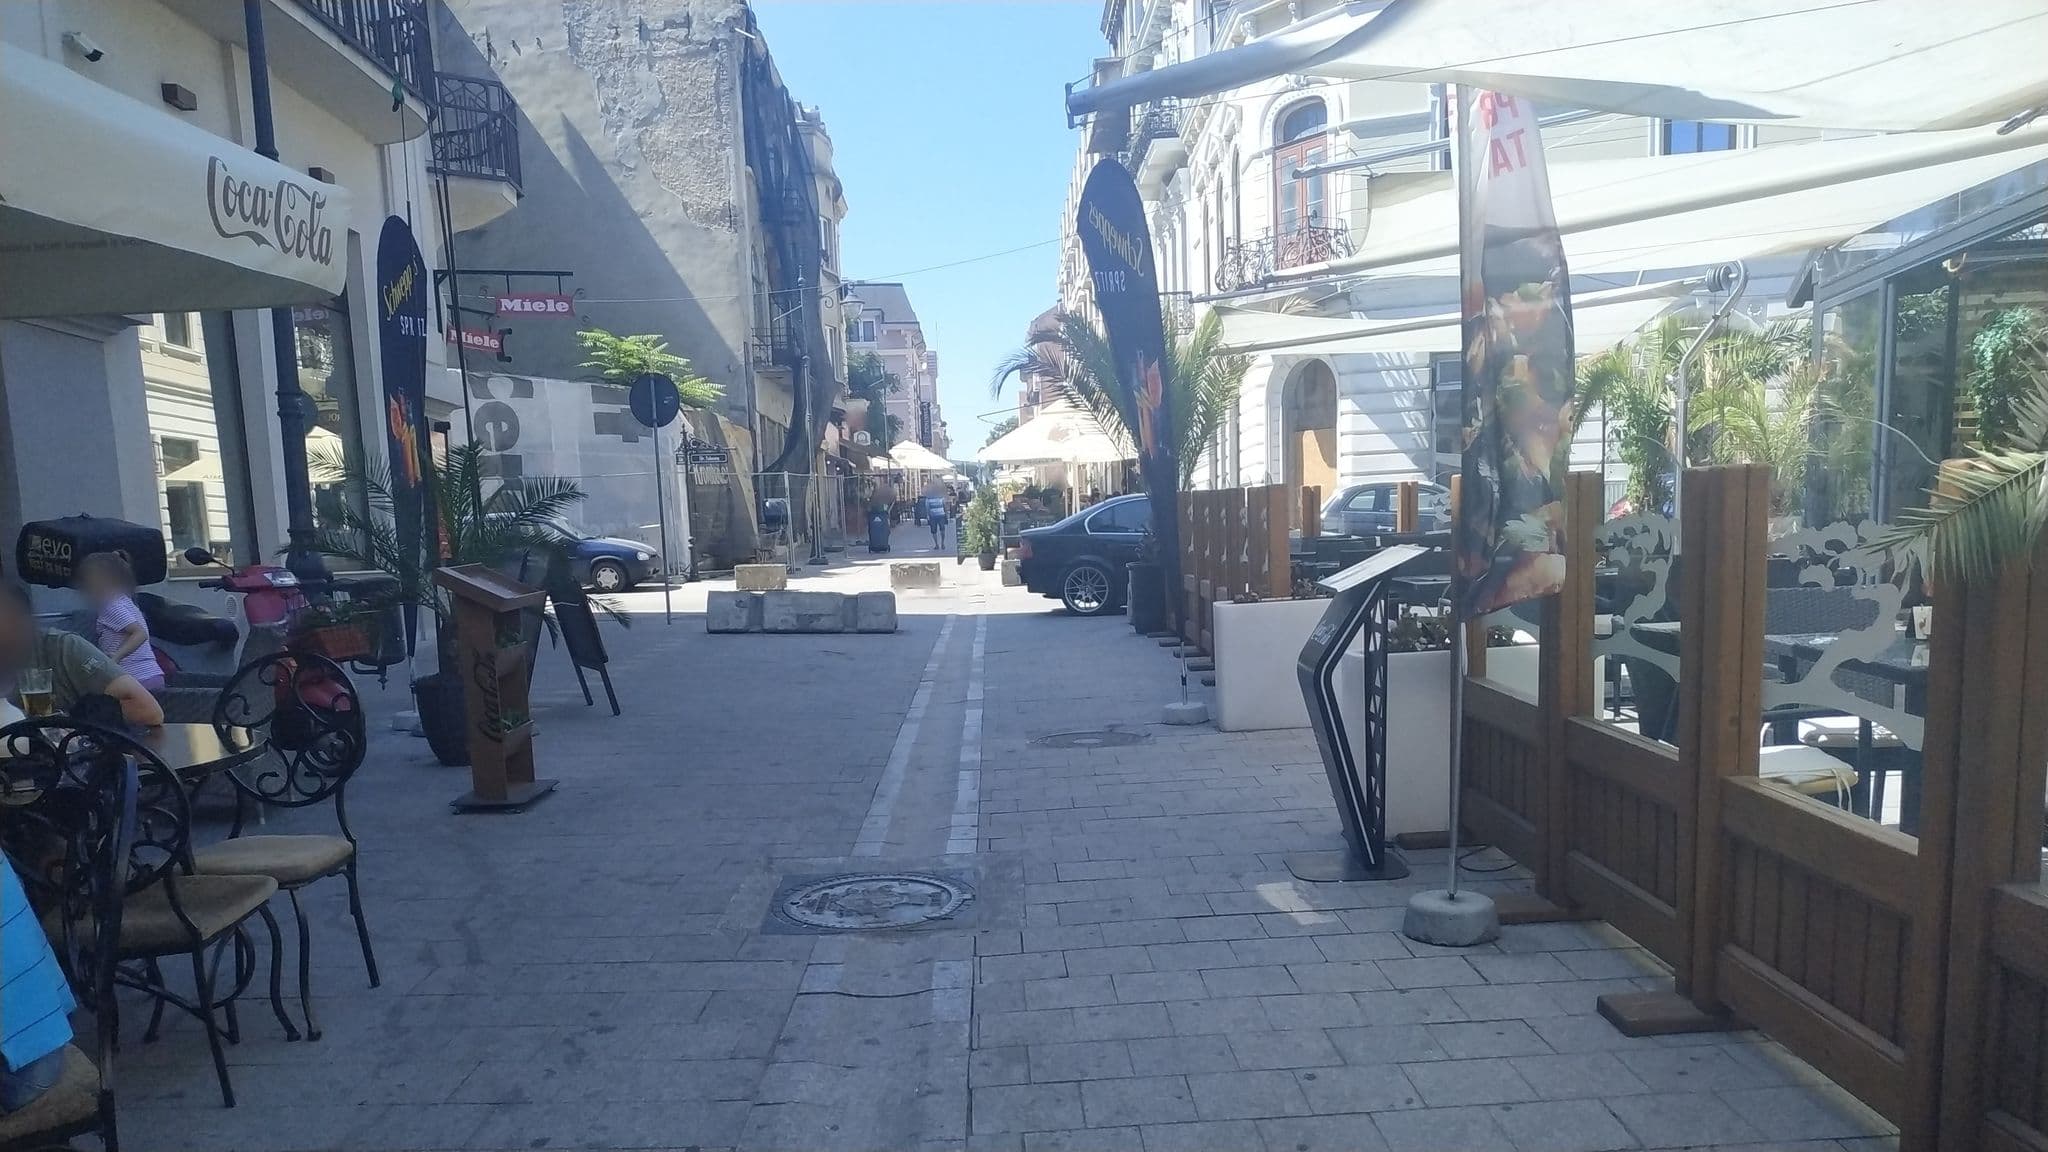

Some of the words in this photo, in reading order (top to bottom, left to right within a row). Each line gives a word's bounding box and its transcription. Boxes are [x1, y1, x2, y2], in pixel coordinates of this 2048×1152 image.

[206, 155, 334, 266] Coca-Cola
[383, 254, 419, 321] Schwepps
[500, 298, 570, 312] Miele
[450, 329, 500, 349] Miele
